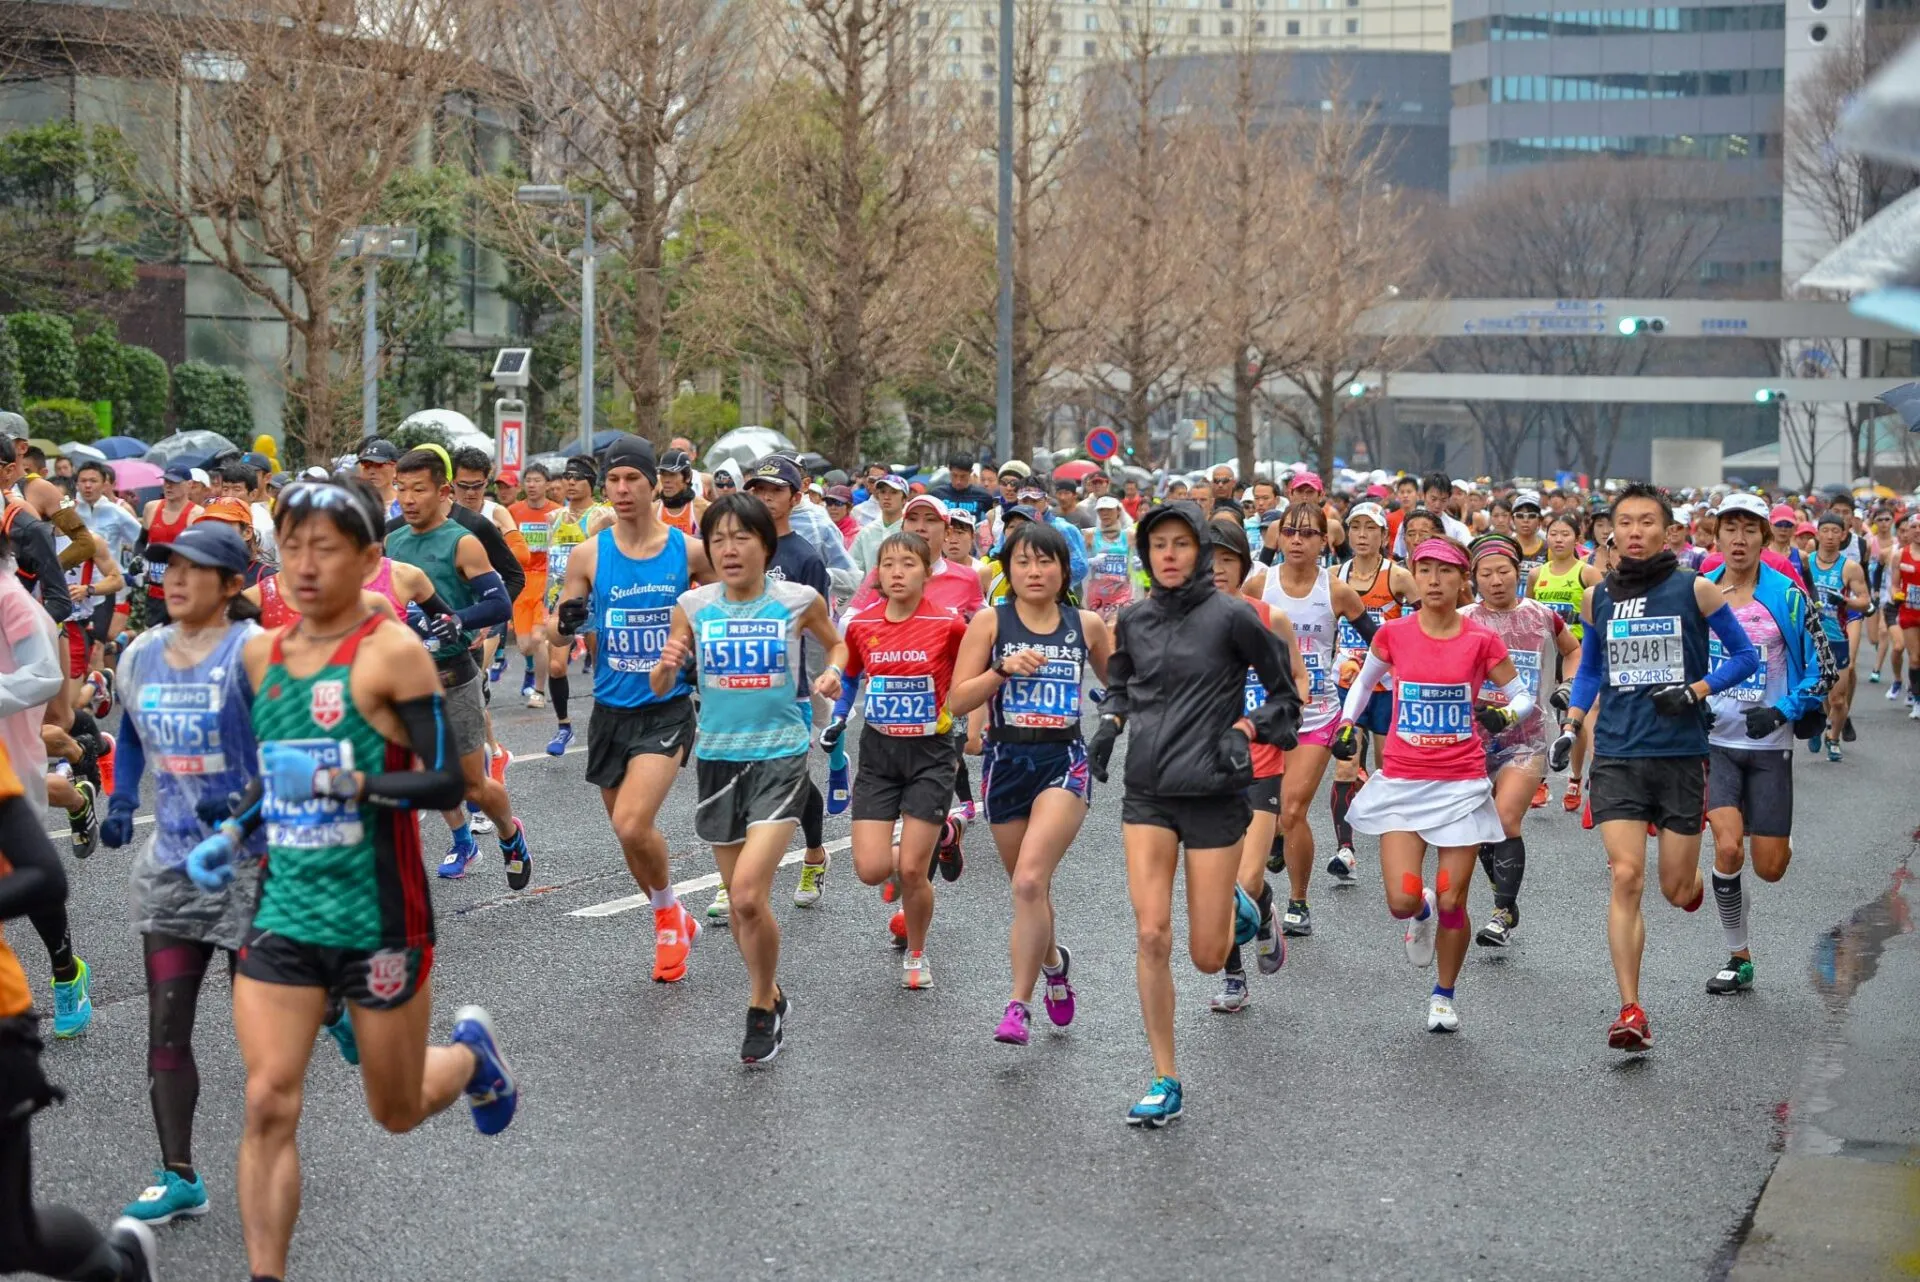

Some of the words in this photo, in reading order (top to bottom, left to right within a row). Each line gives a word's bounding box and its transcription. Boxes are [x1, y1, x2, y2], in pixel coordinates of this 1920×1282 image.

[610, 583, 676, 602] Studenterna
[628, 613, 668, 623] 東京メトロ
[1612, 597, 1647, 620] THE
[729, 624, 776, 634] 東京メトロ
[1631, 622, 1671, 632] 東京メトロ
[607, 629, 667, 653] A8100
[1609, 639, 1668, 664] B29481
[704, 641, 769, 668] A5151
[869, 651, 900, 663] TEAM
[902, 650, 927, 662] ODA
[886, 681, 925, 689] 東京メトロ
[1002, 680, 1065, 709] A5401
[1421, 688, 1463, 697] 東京メトロ
[864, 695, 925, 718] A5292
[1398, 702, 1460, 727] A5010
